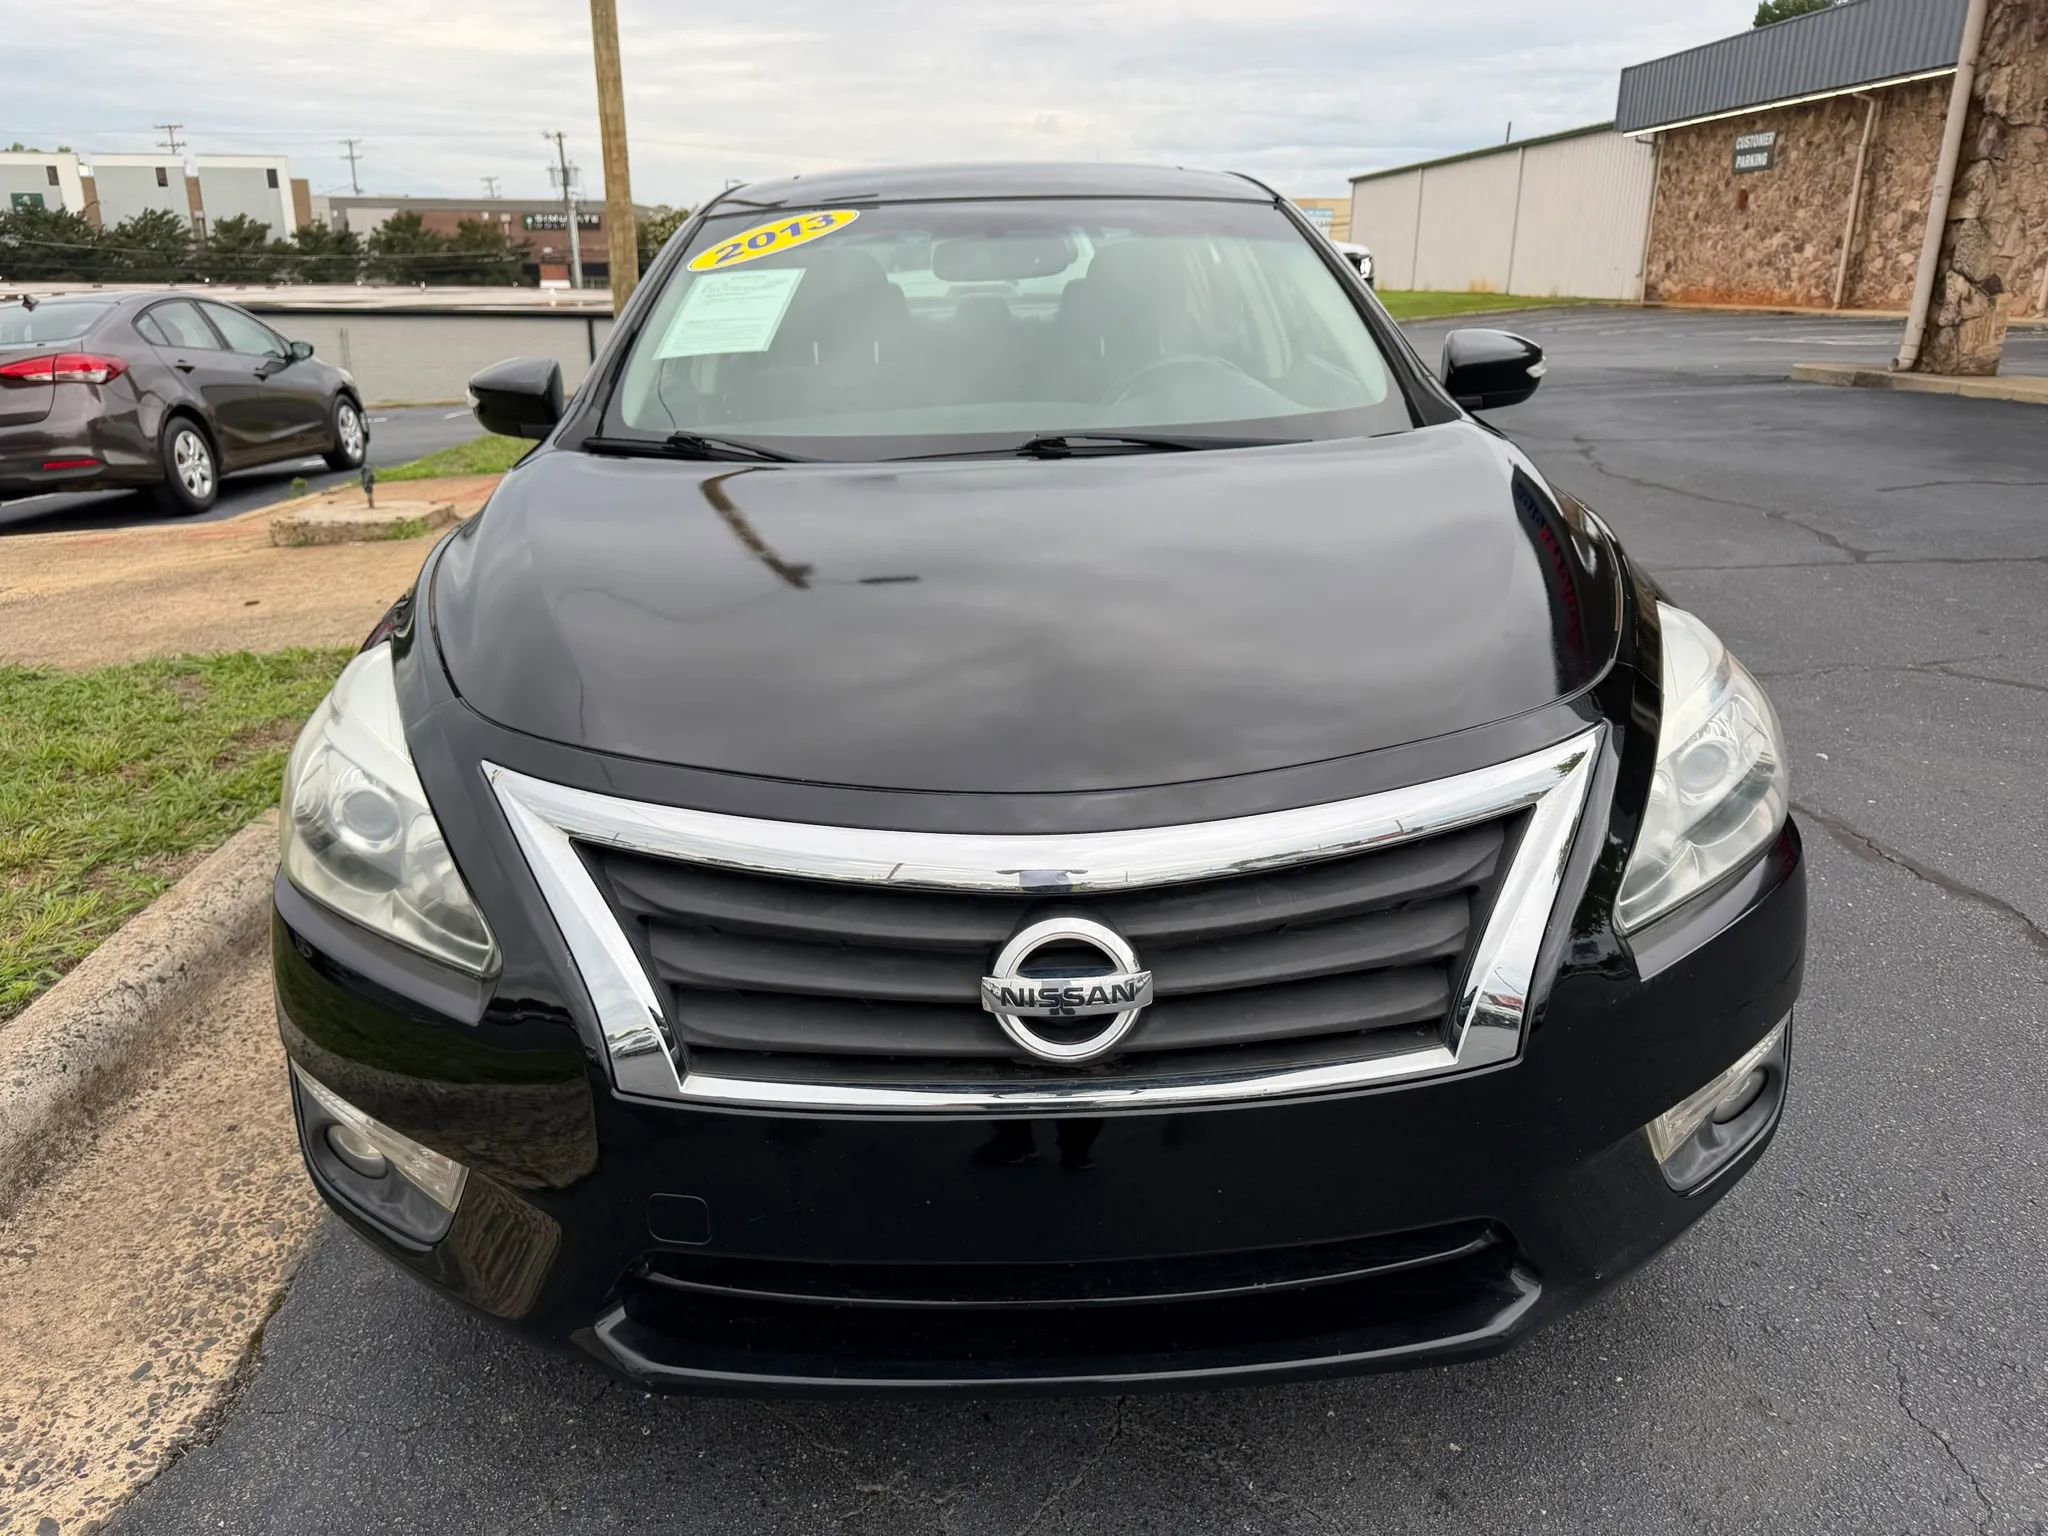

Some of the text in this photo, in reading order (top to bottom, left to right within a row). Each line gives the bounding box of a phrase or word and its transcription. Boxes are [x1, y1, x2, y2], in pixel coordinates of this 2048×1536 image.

[1736, 131, 1776, 150] CUSTOMER
[1736, 152, 1768, 169] PARKING
[534, 213, 600, 223] SIMUATE
[715, 214, 838, 264] 2013
[1000, 982, 1136, 1008] NISSAN
